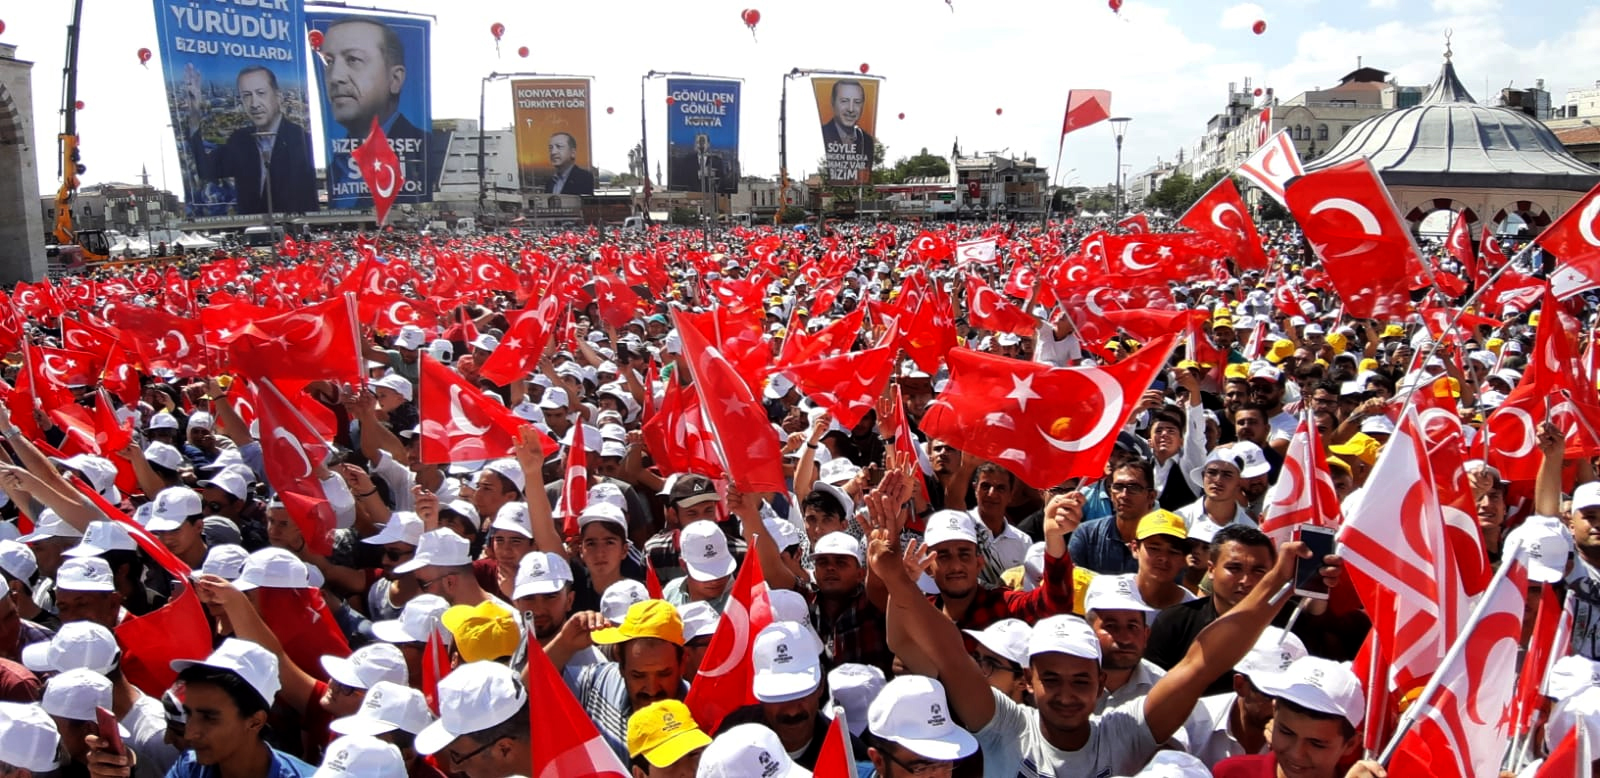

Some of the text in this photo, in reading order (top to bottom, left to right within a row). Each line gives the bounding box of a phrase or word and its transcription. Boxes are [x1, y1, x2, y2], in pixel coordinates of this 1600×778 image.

[170, 3, 291, 42] YÜRÜDÜK
[197, 41, 219, 55] BU
[221, 42, 293, 61] YOLLARDA
[566, 89, 585, 98] BAK
[672, 89, 734, 103] GÖNÜLDEN
[566, 98, 585, 108] GÖR
[680, 102, 726, 115] GÖNÜLE
[827, 141, 858, 153] SÖYLE
